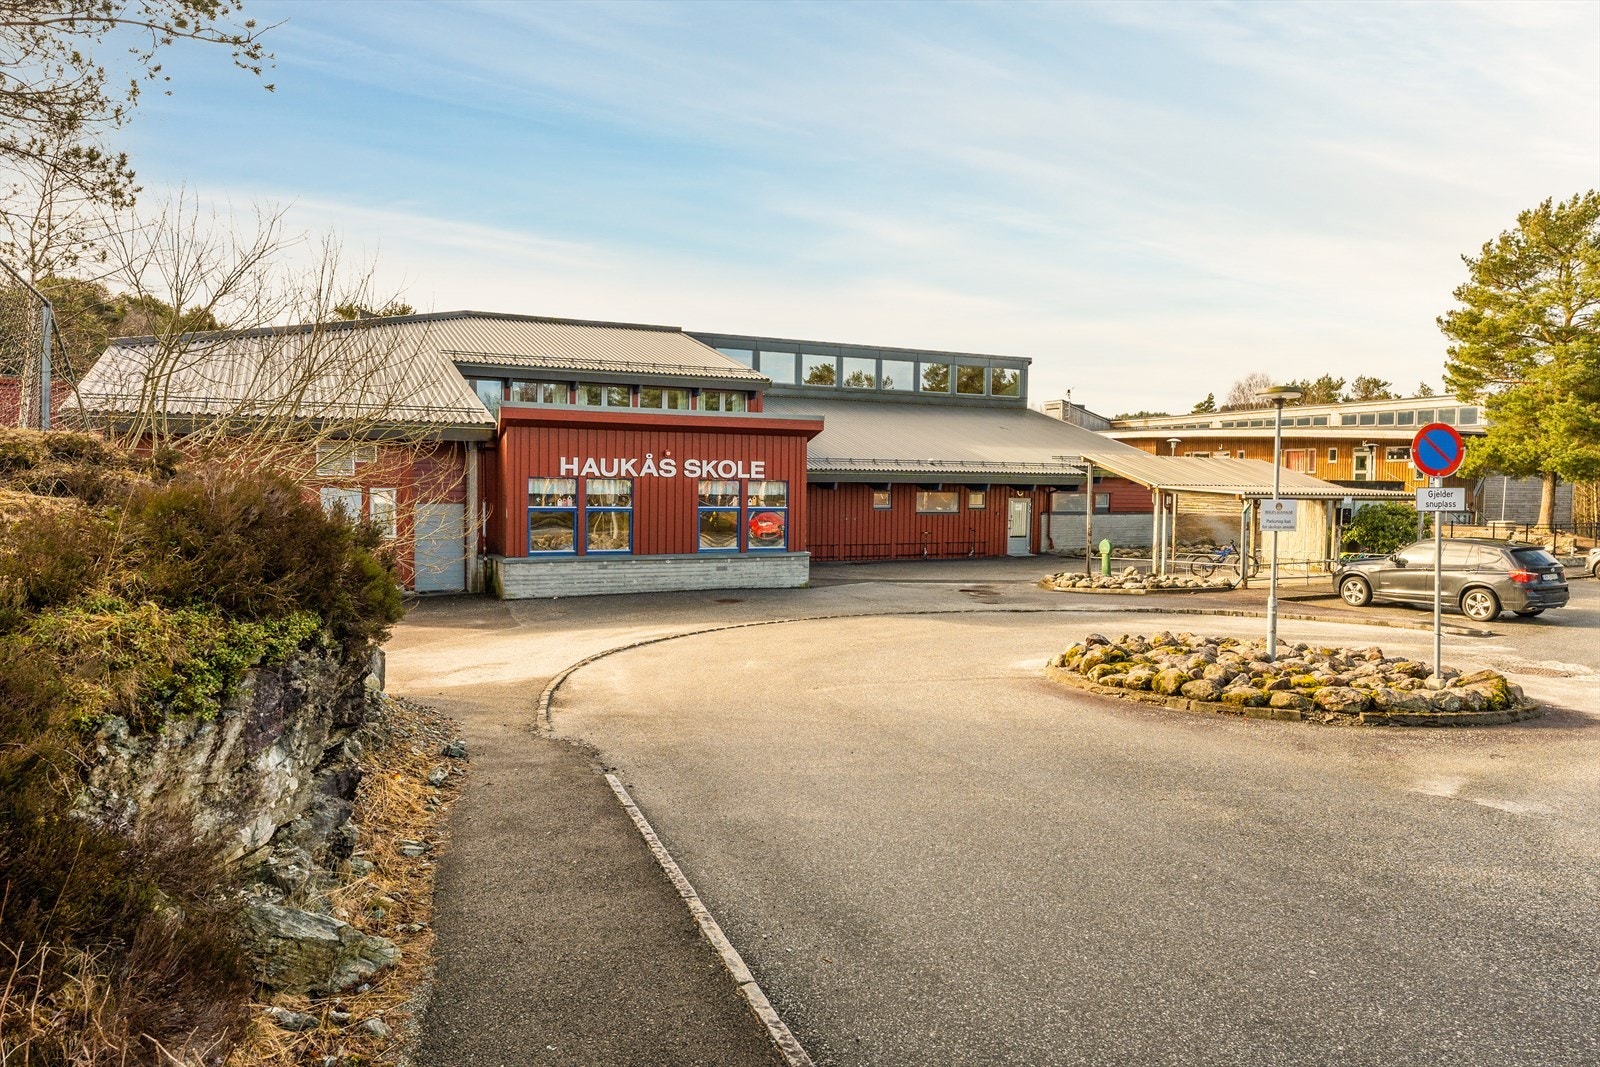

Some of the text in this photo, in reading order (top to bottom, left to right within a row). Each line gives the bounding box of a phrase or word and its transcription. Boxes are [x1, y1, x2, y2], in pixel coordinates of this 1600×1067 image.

[560, 453, 766, 479] HAUKÅS SKOLE
[1427, 490, 1454, 499] Gjelder
[1425, 500, 1457, 509] snuplass
